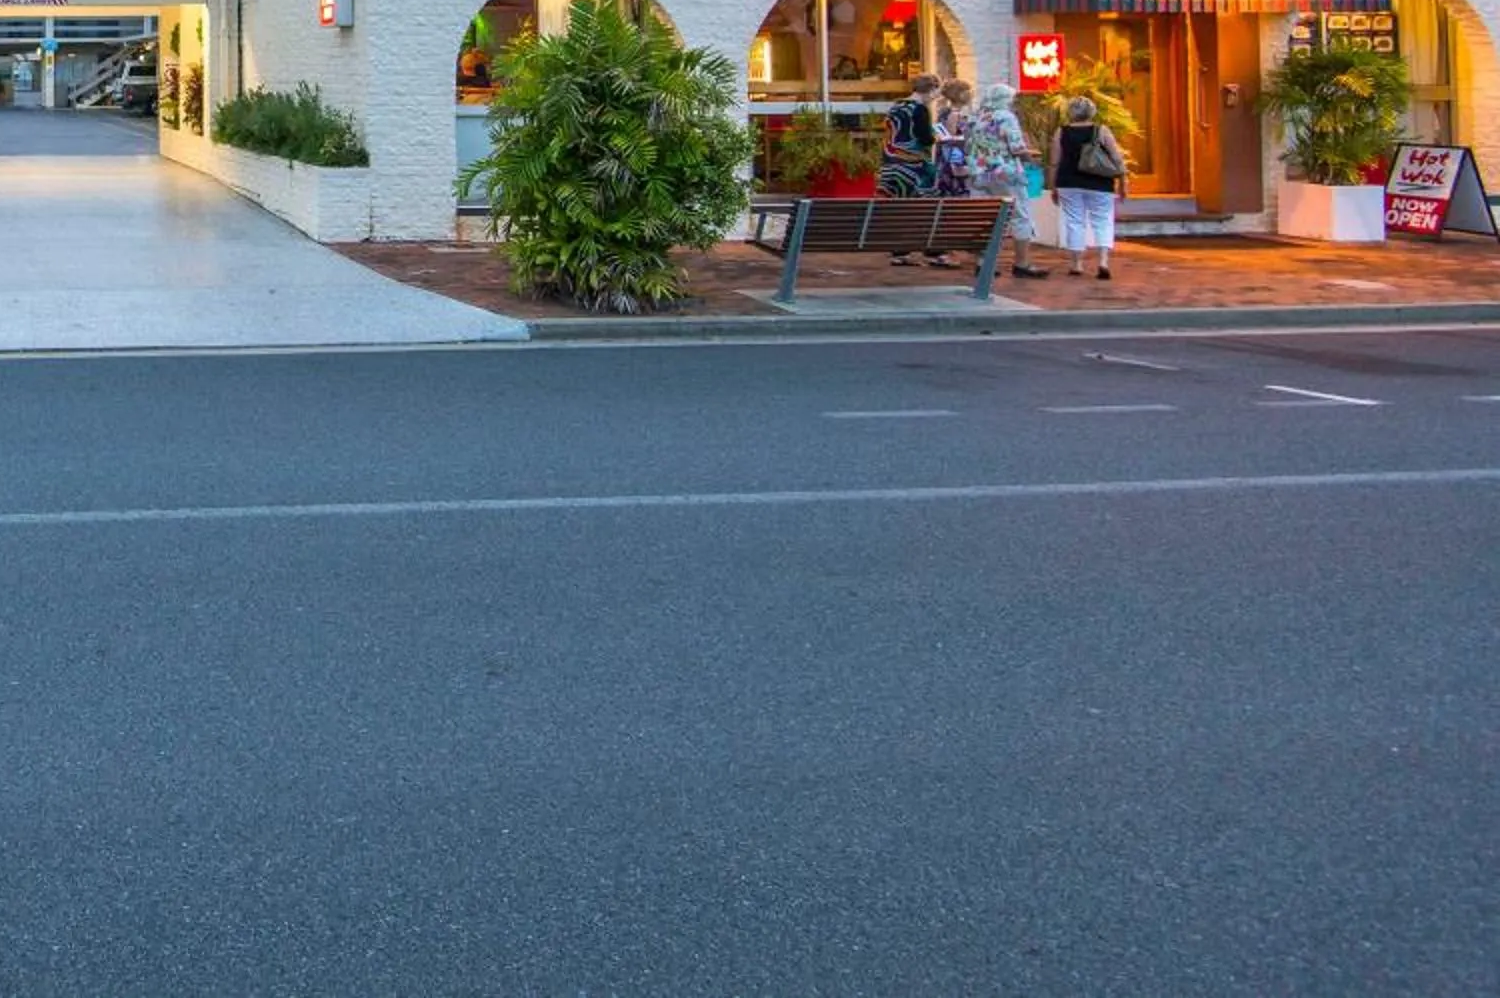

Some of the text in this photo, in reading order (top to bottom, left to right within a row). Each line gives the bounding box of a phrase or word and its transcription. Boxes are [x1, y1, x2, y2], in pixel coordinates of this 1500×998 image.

[1409, 149, 1450, 166] Hot
[1401, 167, 1444, 184] Wok
[1391, 197, 1439, 212] NOW
[1385, 209, 1440, 231] OPEN
